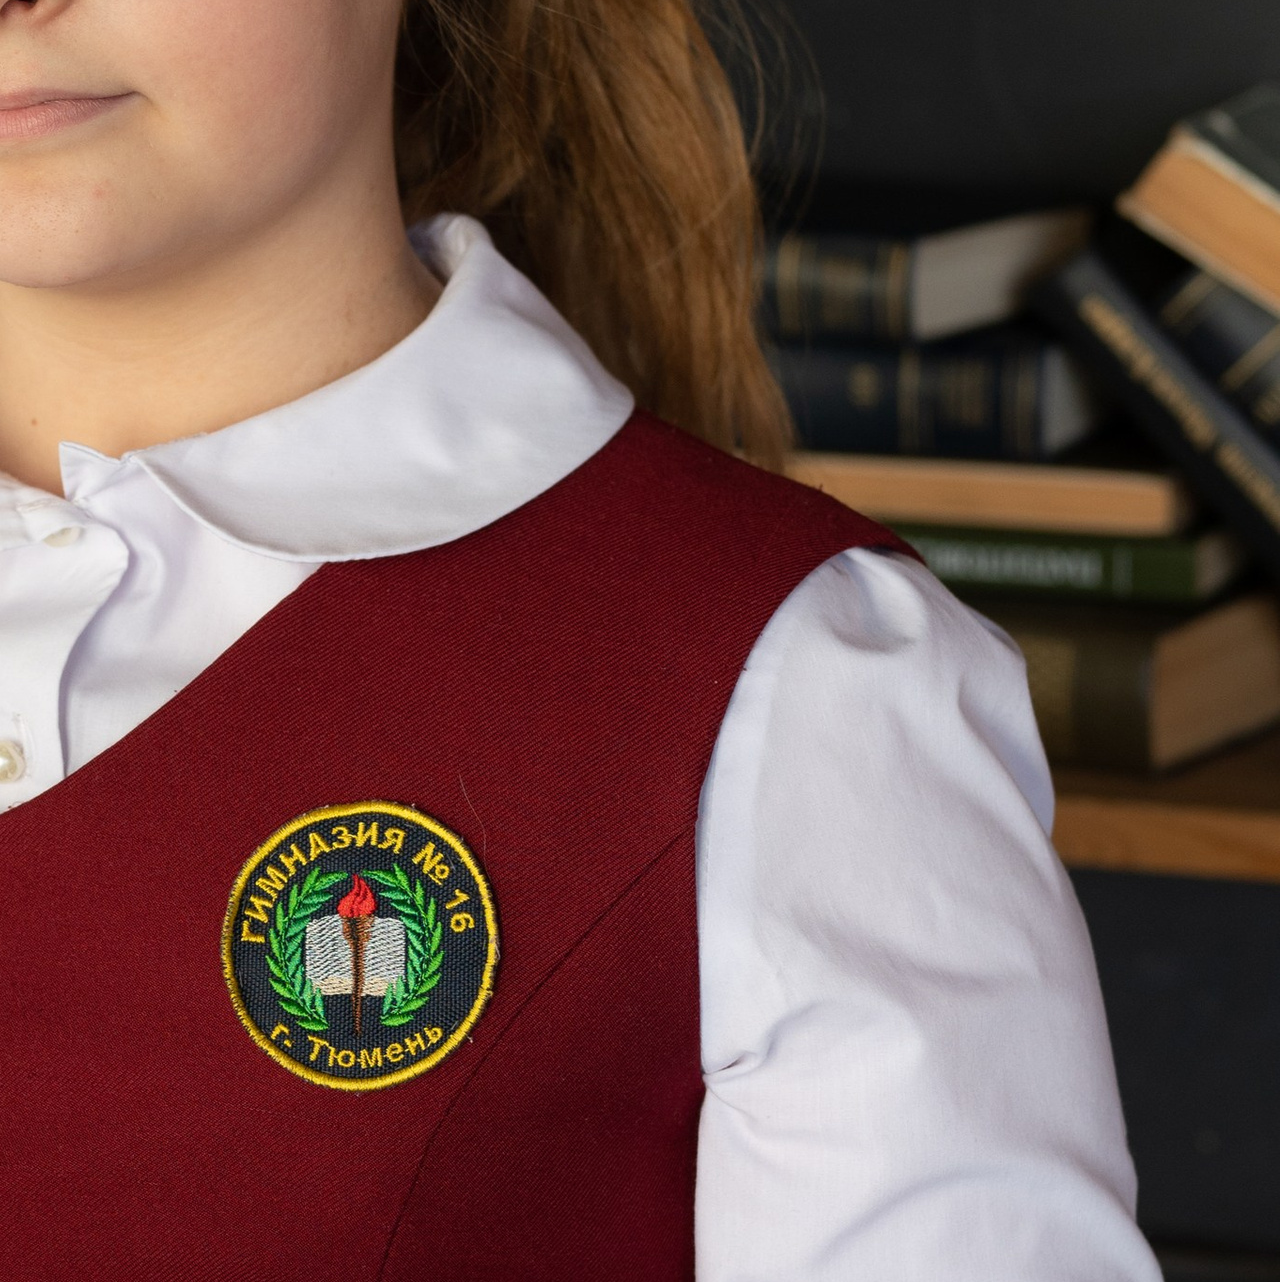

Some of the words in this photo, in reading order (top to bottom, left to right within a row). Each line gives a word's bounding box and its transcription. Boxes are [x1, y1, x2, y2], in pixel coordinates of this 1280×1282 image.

[241, 822, 407, 944] ГИМНАЗИЯ
[413, 843, 451, 885] №
[445, 888, 475, 933] 16
[270, 1023, 293, 1048] г.
[308, 1025, 443, 1069] Тюмень
